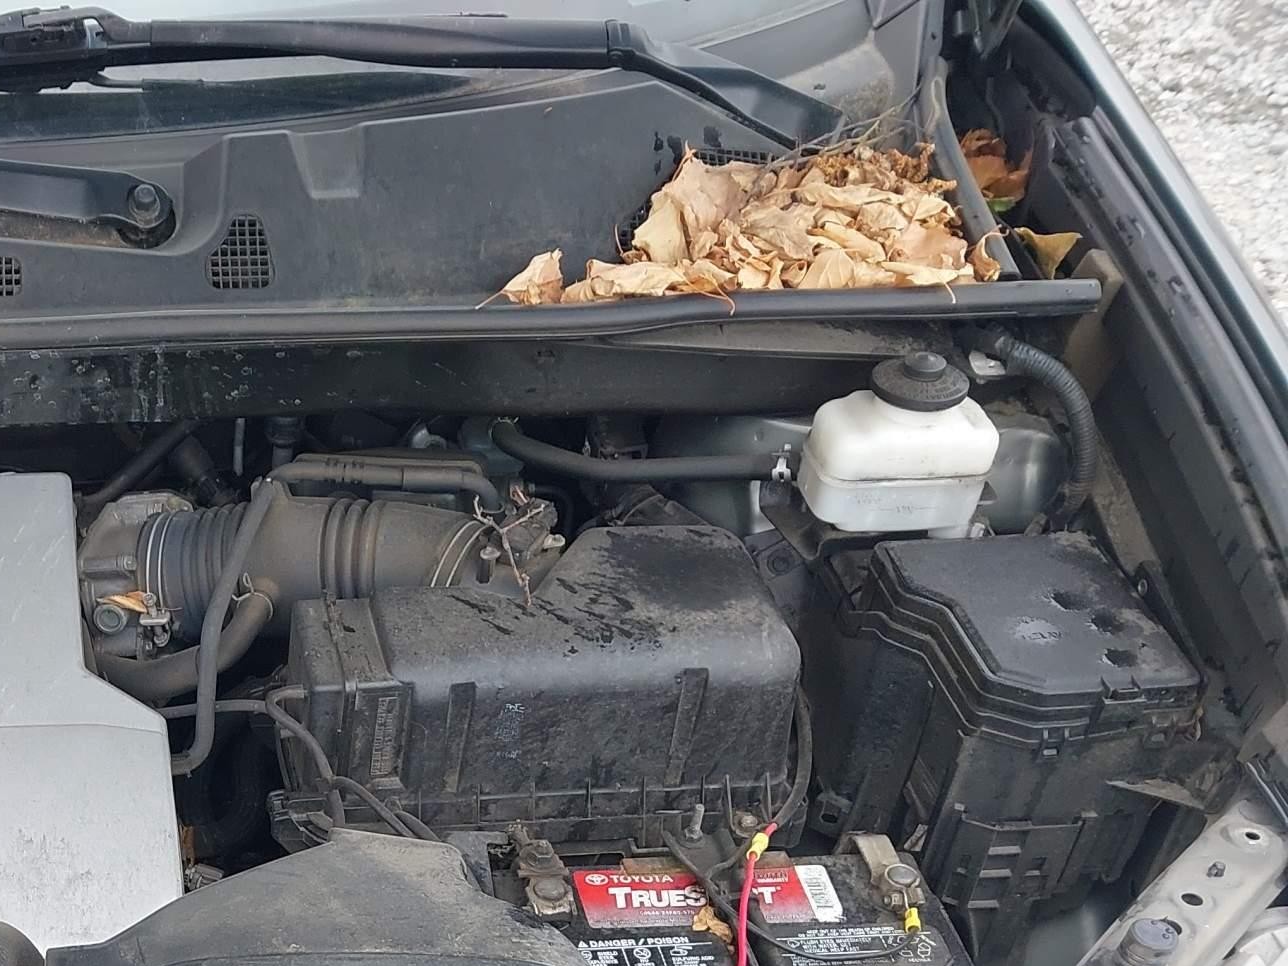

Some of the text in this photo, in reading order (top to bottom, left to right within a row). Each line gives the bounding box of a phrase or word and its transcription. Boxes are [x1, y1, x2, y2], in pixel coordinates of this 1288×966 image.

[609, 874, 674, 884] TOYOTA
[589, 938, 636, 948] DANGER
[647, 936, 689, 945] POISON
